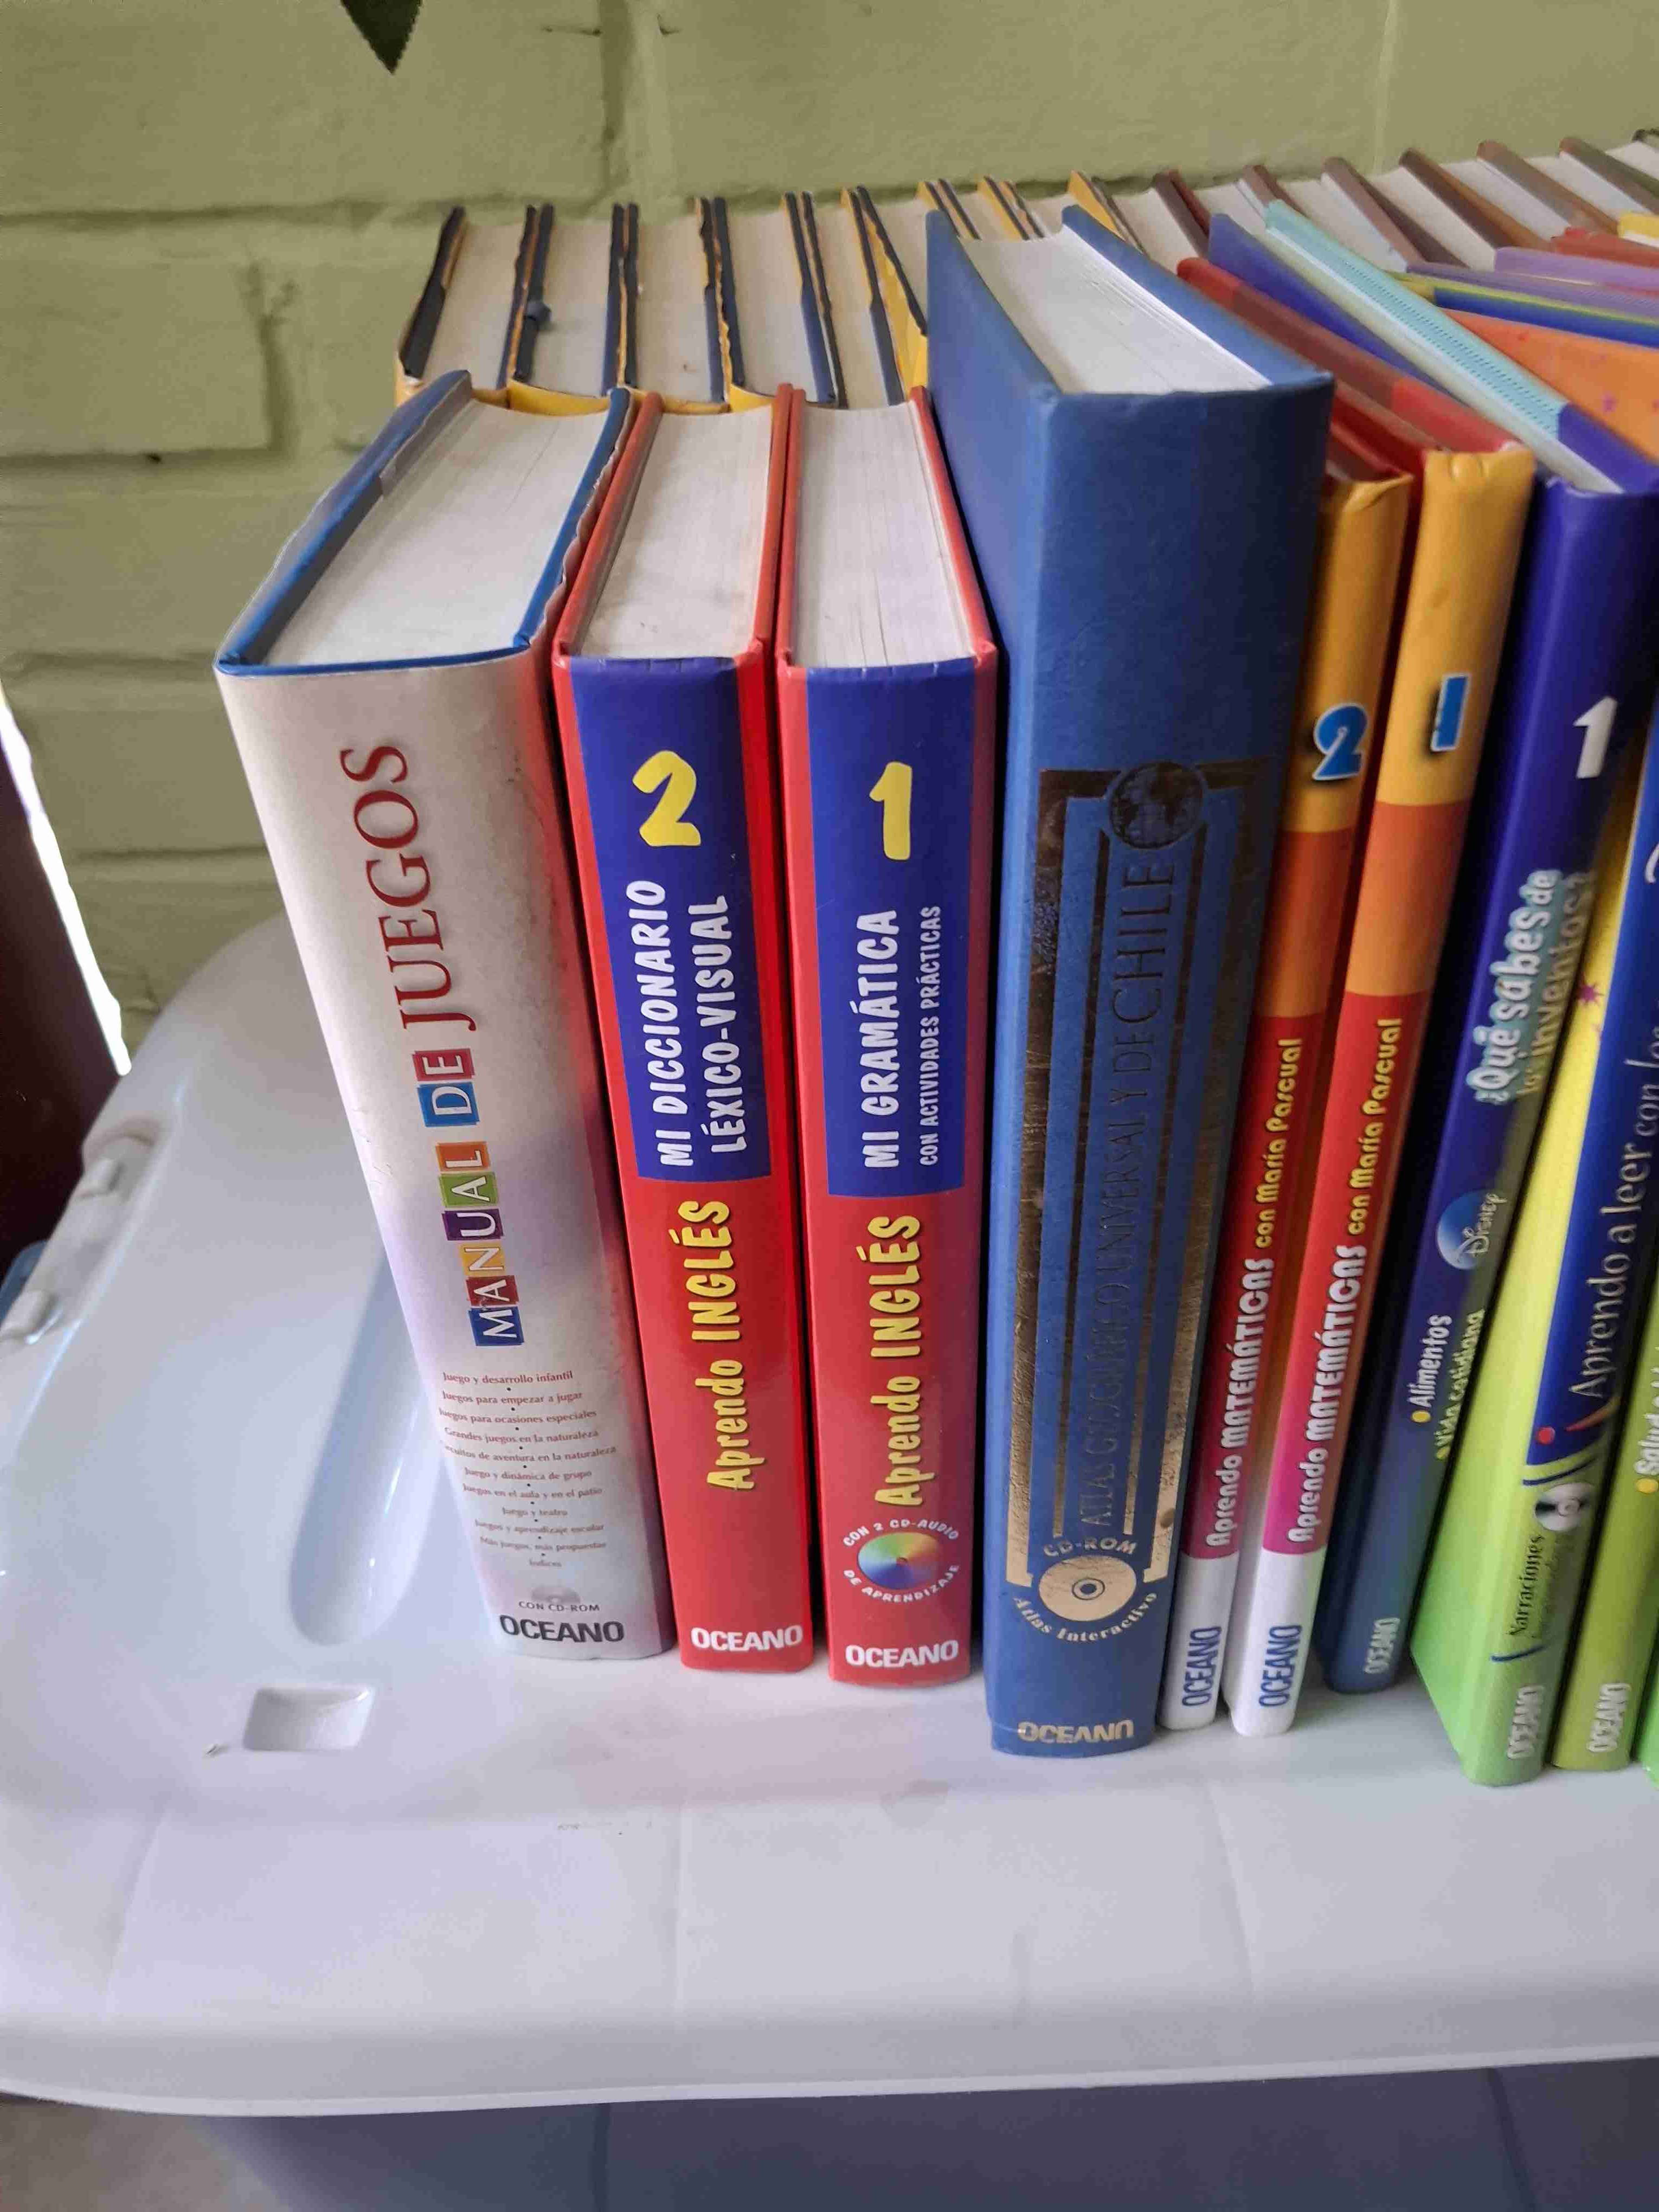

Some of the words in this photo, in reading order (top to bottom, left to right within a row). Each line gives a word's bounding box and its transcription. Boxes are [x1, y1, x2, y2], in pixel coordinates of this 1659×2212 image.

[1313, 702, 1369, 781] 2
[1574, 696, 1617, 779] 1
[632, 750, 701, 847] 2
[869, 761, 913, 860] 1
[340, 746, 476, 1031] JUEGOS
[1520, 870, 1562, 906] de
[915, 905, 942, 1009] PRÁCTICAS
[1113, 861, 1174, 1024] CHILE
[1489, 906, 1551, 1021] sabes
[626, 879, 687, 1115] DICCIONARIO
[688, 895, 749, 1153] LÉXICO-VISUAL
[849, 909, 900, 1117] GRAMÁTICA
[419, 1052, 475, 1119] DE
[918, 1015, 940, 1127] ACTIVIDADES
[1114, 1031, 1155, 1077] DE
[1266, 1039, 1303, 1133] Pascual
[1361, 1018, 1403, 1116] Pascual
[1467, 1025, 1522, 1105] ¿Qué
[1110, 1086, 1148, 1107] Y
[655, 1130, 694, 1167] MI
[861, 1131, 899, 1169] MI
[918, 1133, 938, 1167] CON
[1256, 1138, 1287, 1204] María
[1349, 1122, 1384, 1189] María
[1600, 1141, 1653, 1214] leer
[440, 1146, 520, 1342] MANUAL
[1256, 1209, 1277, 1249] con
[1348, 1194, 1371, 1235] con
[1607, 1224, 1637, 1245] a
[668, 1200, 742, 1342] INGLÉS
[856, 1215, 922, 1357] INGLÉS
[1221, 1258, 1274, 1449] MATEMÁTICAS
[1306, 1245, 1367, 1442] MATEMÁTICAS
[1407, 1314, 1452, 1408] Alimentos
[1569, 1252, 1631, 1397] Aprendo
[442, 1391, 473, 1403] Juegos
[476, 1396, 498, 1405] para
[501, 1396, 544, 1405] empezar
[557, 1392, 583, 1402] jugar
[443, 1372, 470, 1384] Juego
[482, 1375, 533, 1384] desarrollo
[537, 1370, 573, 1382] infantil
[445, 1427, 483, 1441] Grandes
[486, 1435, 517, 1444] juegos
[534, 1435, 544, 1443] la
[546, 1430, 599, 1442] naturaleza
[471, 1414, 492, 1424] para
[546, 1410, 597, 1424] especiales
[478, 1452, 490, 1460] de
[493, 1454, 535, 1462] aventura
[553, 1452, 562, 1461] la
[564, 1446, 616, 1459] naturaleza
[695, 1359, 766, 1491] Aprendo
[870, 1375, 935, 1506] Aprendo
[465, 1467, 491, 1480] Juego
[501, 1471, 545, 1480] dinámica
[549, 1471, 560, 1480] de
[564, 1470, 592, 1481] grupo
[566, 1489, 575, 1497] el
[1206, 1454, 1242, 1547] Aprendo
[1288, 1447, 1328, 1543] Aprendo
[843, 1526, 870, 1547] CON
[873, 1522, 884, 1532] 2
[889, 1519, 959, 1540] CD-AUDIO
[1044, 1536, 1137, 1557] CD-ROM
[519, 1600, 544, 1610] CON
[548, 1603, 600, 1612] CD-ROM
[844, 1570, 863, 1586] DE
[861, 1565, 959, 1603] APRENDIZAJE
[1013, 1596, 1052, 1634] Atlas
[1056, 1592, 1158, 1642] Interactivo
[1506, 1535, 1545, 1636] Narraciones
[499, 1614, 625, 1643] OCEANO
[691, 1624, 803, 1653] OCEANO
[845, 1639, 959, 1668] OCEANO
[1182, 1626, 1222, 1707] OCEANO
[1258, 1624, 1302, 1707] OCEANO
[1017, 1719, 1134, 1744] OCEANO
